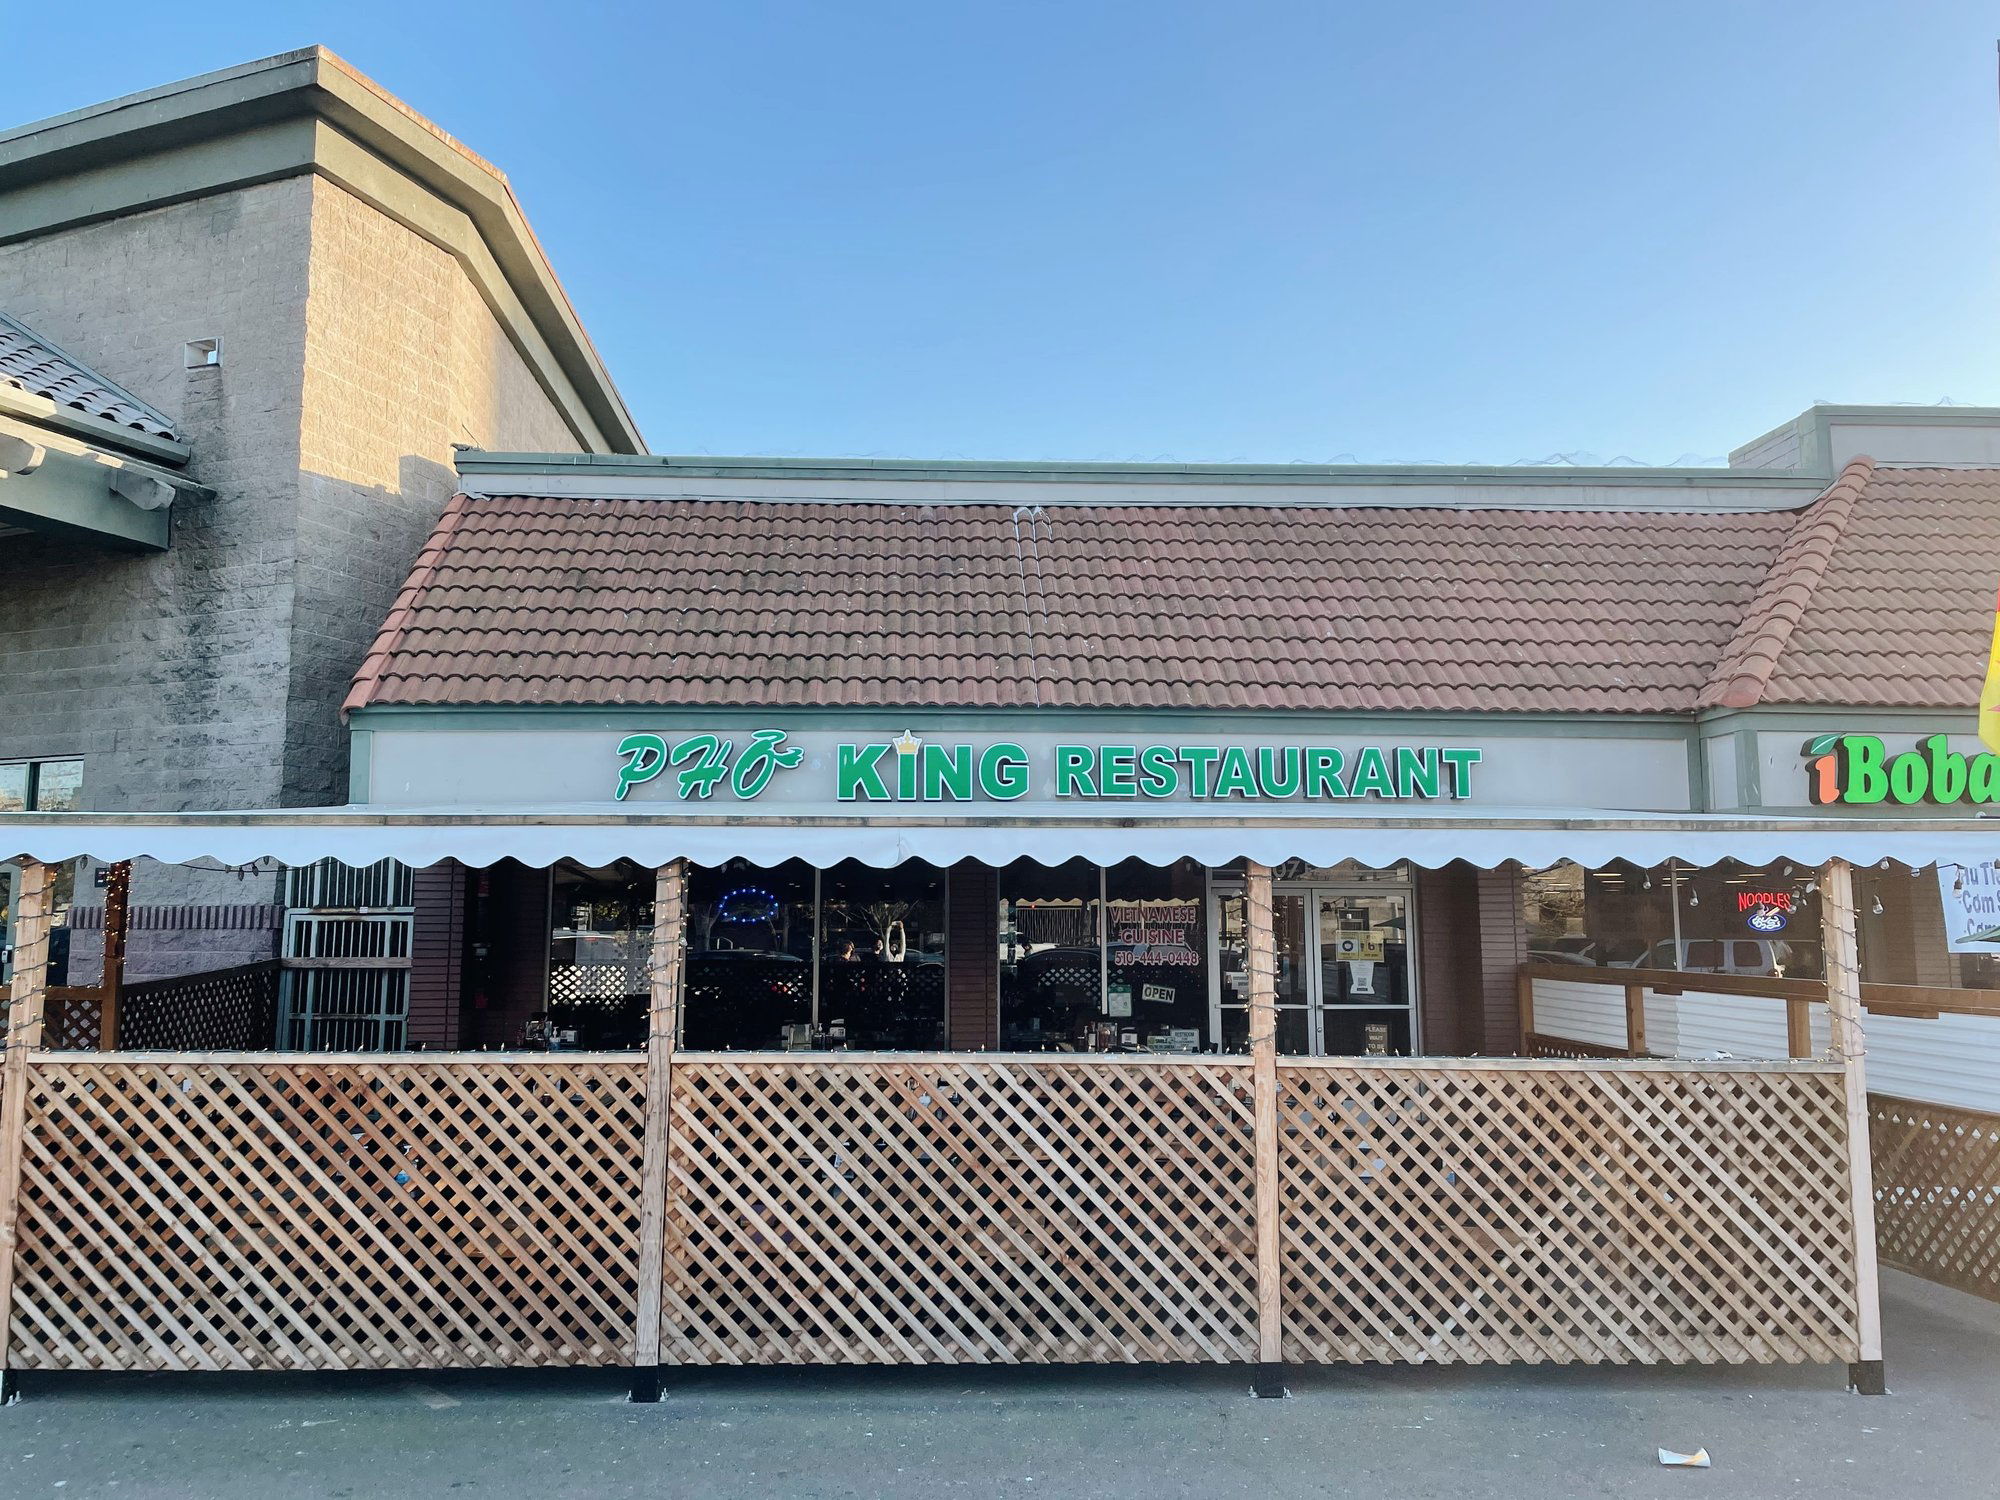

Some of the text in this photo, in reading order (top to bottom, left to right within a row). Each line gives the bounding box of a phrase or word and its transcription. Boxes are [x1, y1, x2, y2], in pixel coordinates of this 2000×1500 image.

[836, 733, 1030, 802] KING
[1055, 743, 1483, 800] RESTAURANT
[1810, 733, 2000, 805] iBoba
[1738, 892, 1792, 912] NOODLES
[1109, 906, 1196, 924] VIETNAMESE
[1120, 928, 1185, 945] CUISINE
[1115, 950, 1199, 966] 510-444-0448
[1144, 987, 1174, 1002] OPEN
